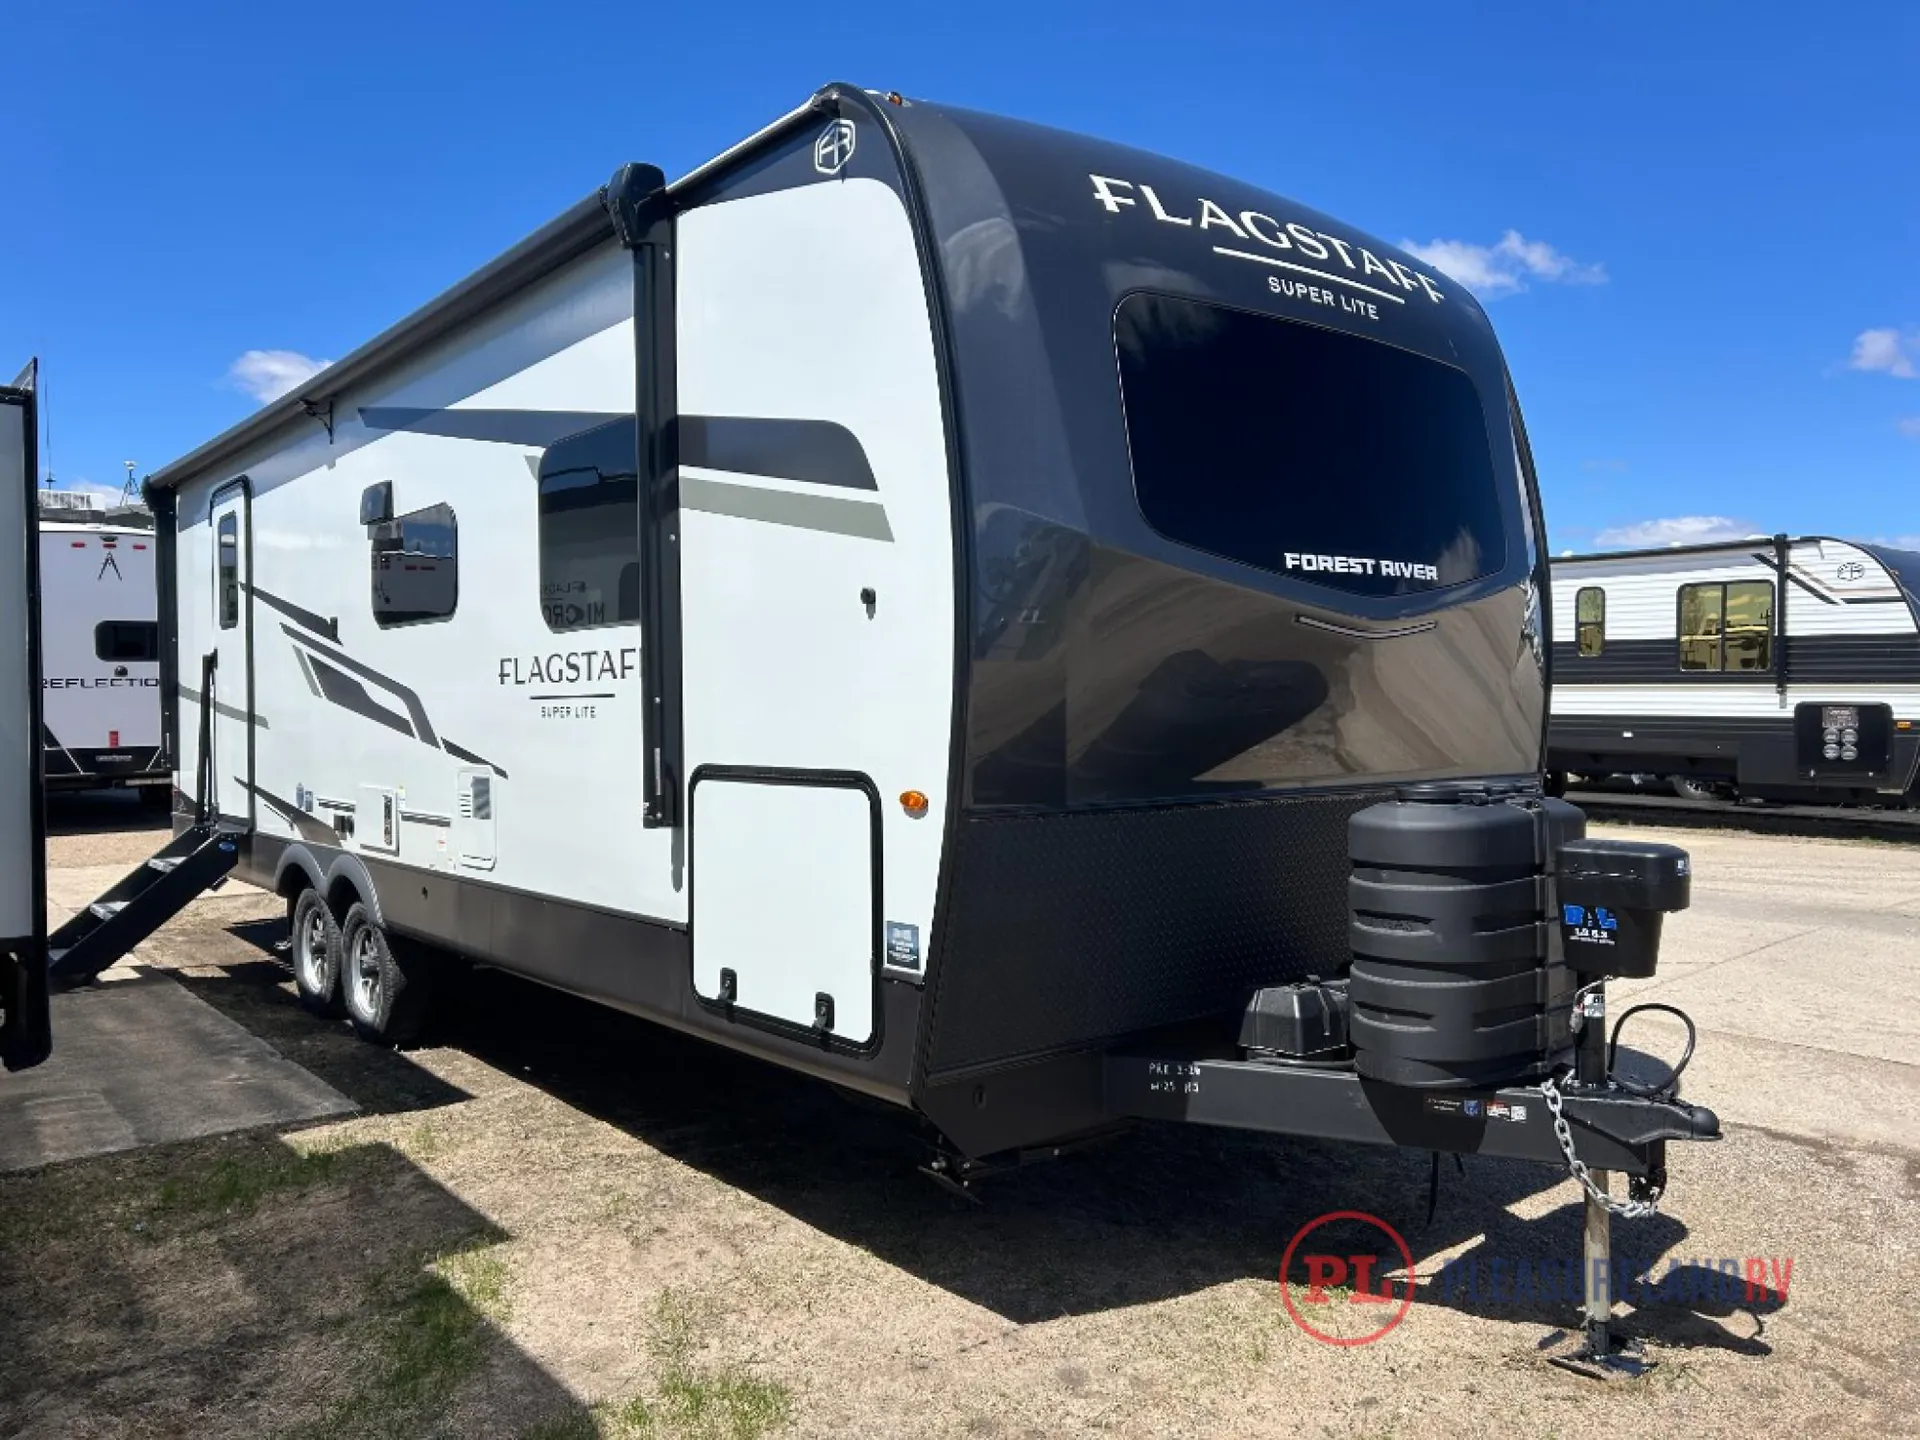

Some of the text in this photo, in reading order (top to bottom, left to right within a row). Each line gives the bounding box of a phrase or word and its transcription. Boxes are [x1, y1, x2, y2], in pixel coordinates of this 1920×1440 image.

[1089, 173, 1445, 304] FLAGSTAFF
[1268, 275, 1379, 320] SUPER LITE
[1284, 552, 1438, 580] FOREST RIVER
[499, 648, 641, 685] FLAGSTAF
